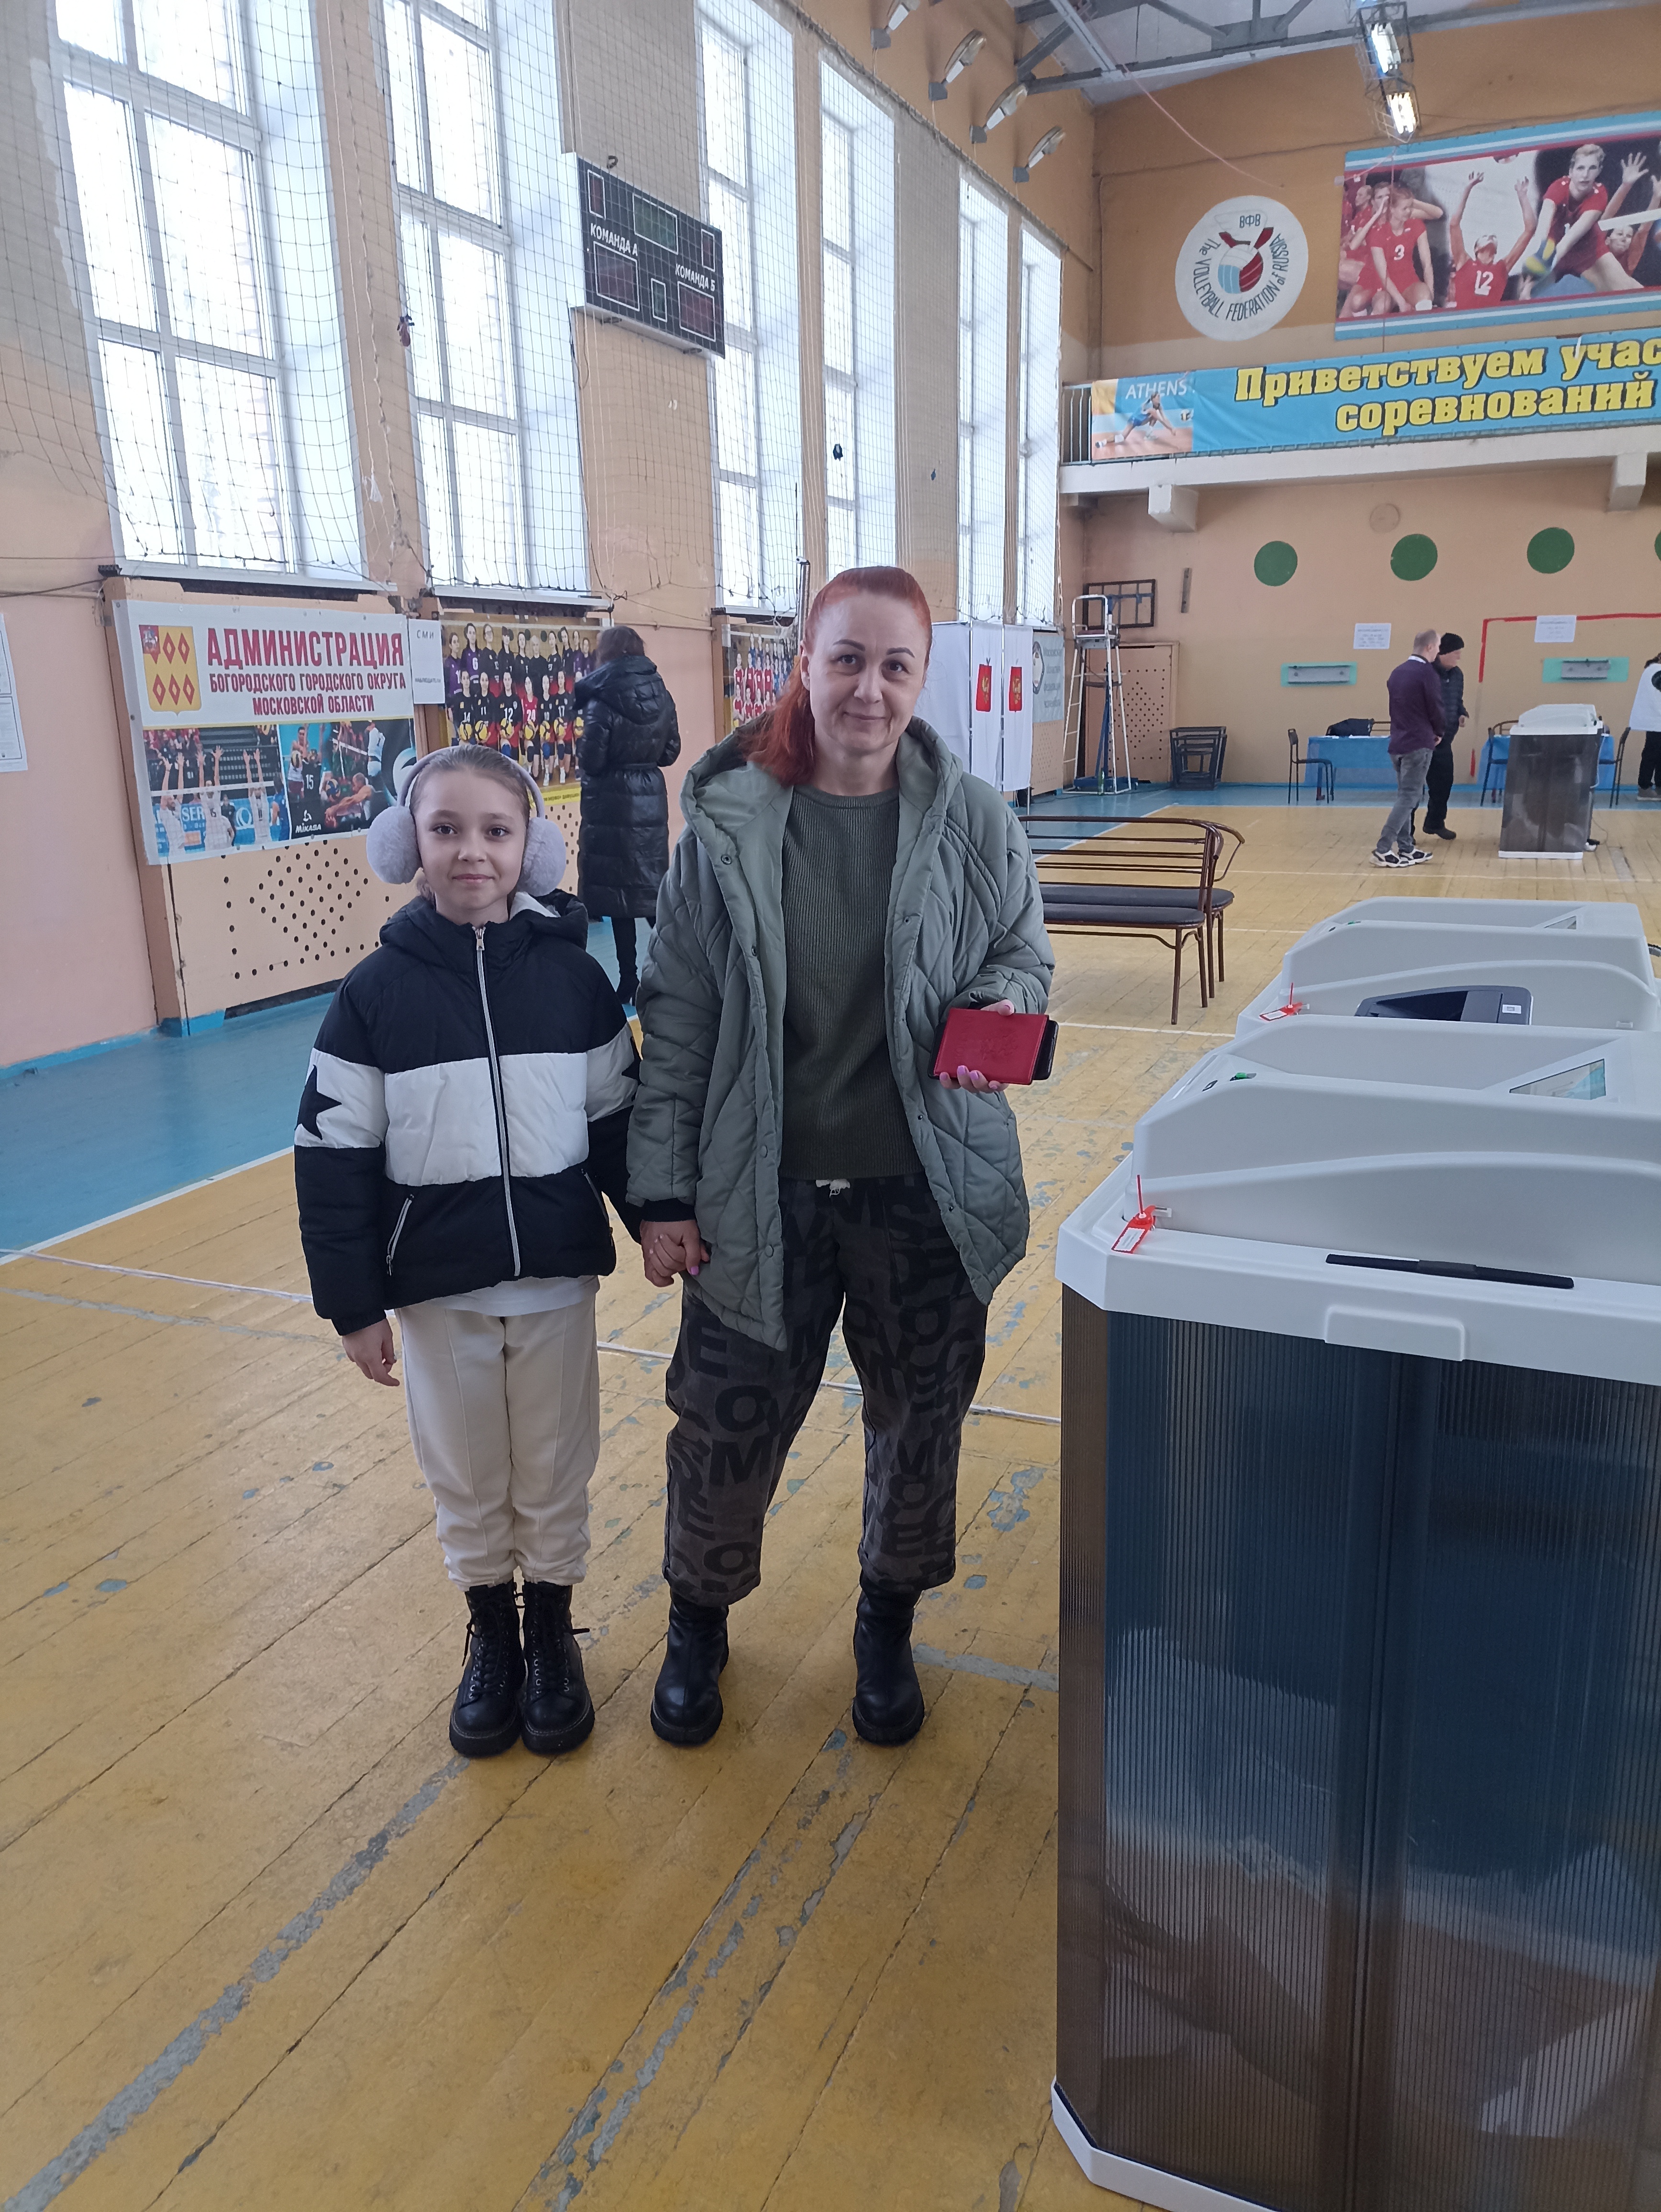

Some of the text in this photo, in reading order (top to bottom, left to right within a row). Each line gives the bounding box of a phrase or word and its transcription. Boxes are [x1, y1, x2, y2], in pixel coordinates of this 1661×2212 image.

[1240, 214, 1261, 228] ВФВ
[590, 222, 638, 256] КОМАНДА А
[1394, 244, 1405, 260] 3
[675, 263, 715, 292] КОМАНДА Б
[1193, 258, 1225, 318] VOLLEYBALL
[1225, 280, 1281, 321] FEDERATION
[1269, 233, 1289, 272] RUSSIA
[1474, 270, 1494, 296] 12
[1235, 337, 1661, 407] Приветствуем учас
[1125, 379, 1187, 399] ATHENS
[1336, 371, 1655, 436] соревнований
[208, 628, 404, 670] АДМИНИСТРАЦИЯ
[209, 673, 406, 694] БОГОРОДСКОГО ГОРОДСКОГО ОКРУГА
[253, 694, 375, 715] МОСКОВСКОЙ ОБЛАСТИ
[306, 774, 314, 790] 15
